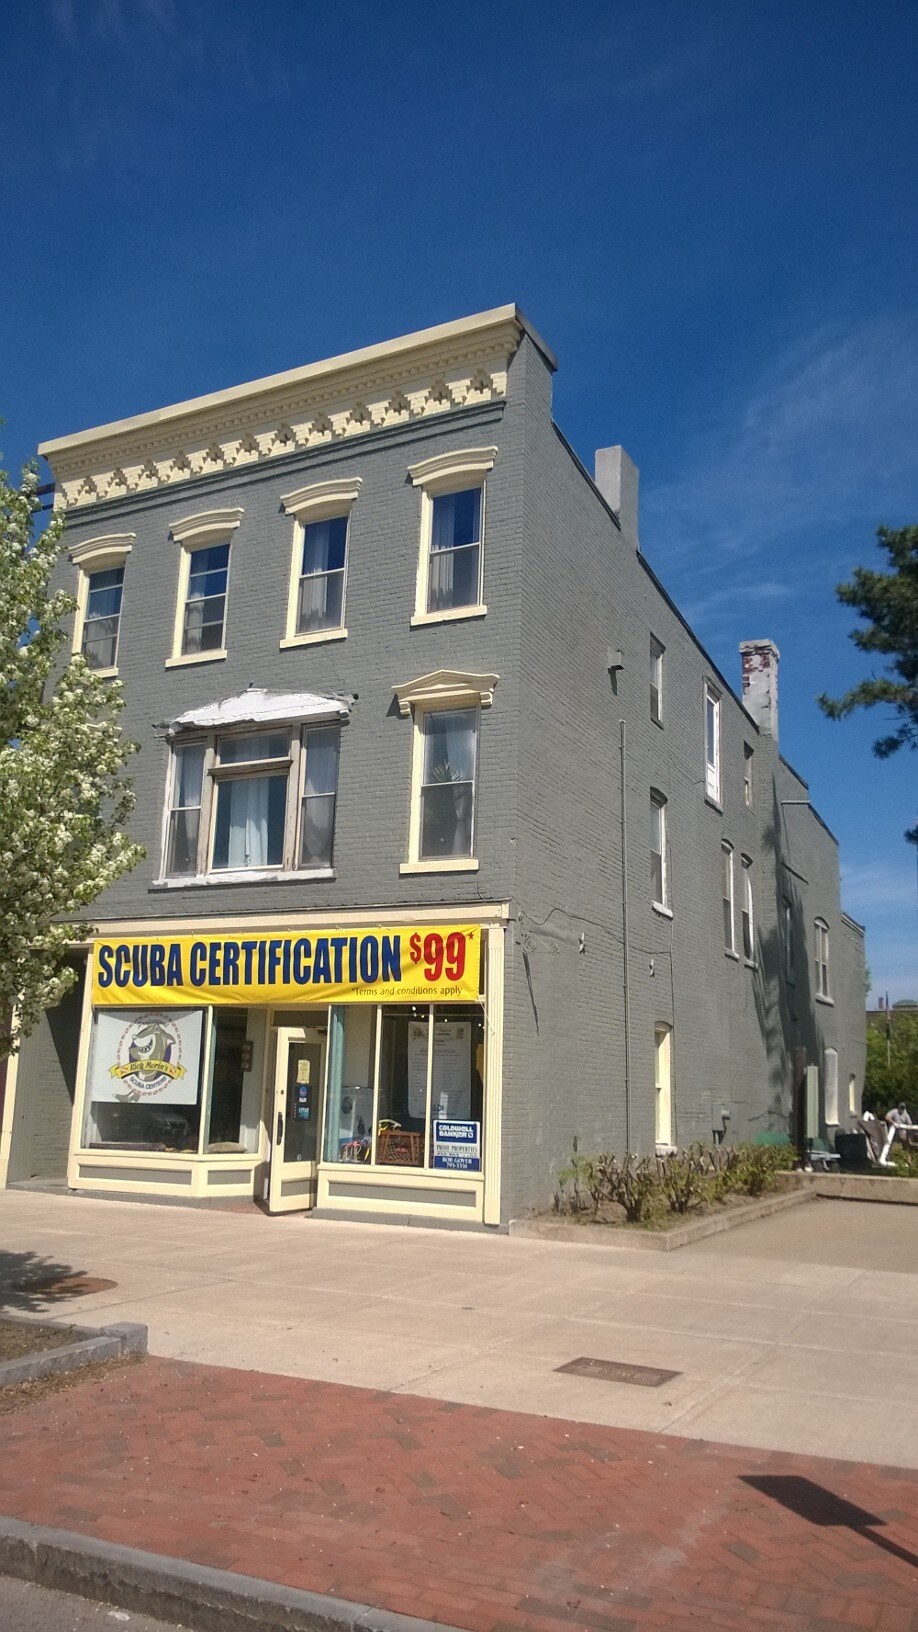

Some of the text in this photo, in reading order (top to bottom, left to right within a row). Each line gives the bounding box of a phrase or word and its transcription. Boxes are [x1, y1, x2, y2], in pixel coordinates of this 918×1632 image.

[98, 943, 184, 988] SCUBA
[190, 935, 401, 986] CERTIFICATION
[380, 986, 395, 995] and
[397, 985, 437, 995] conditions
[440, 984, 462, 997] apply
[129, 1076, 145, 1089] SCUBA
[439, 1130, 467, 1138] BANKER
